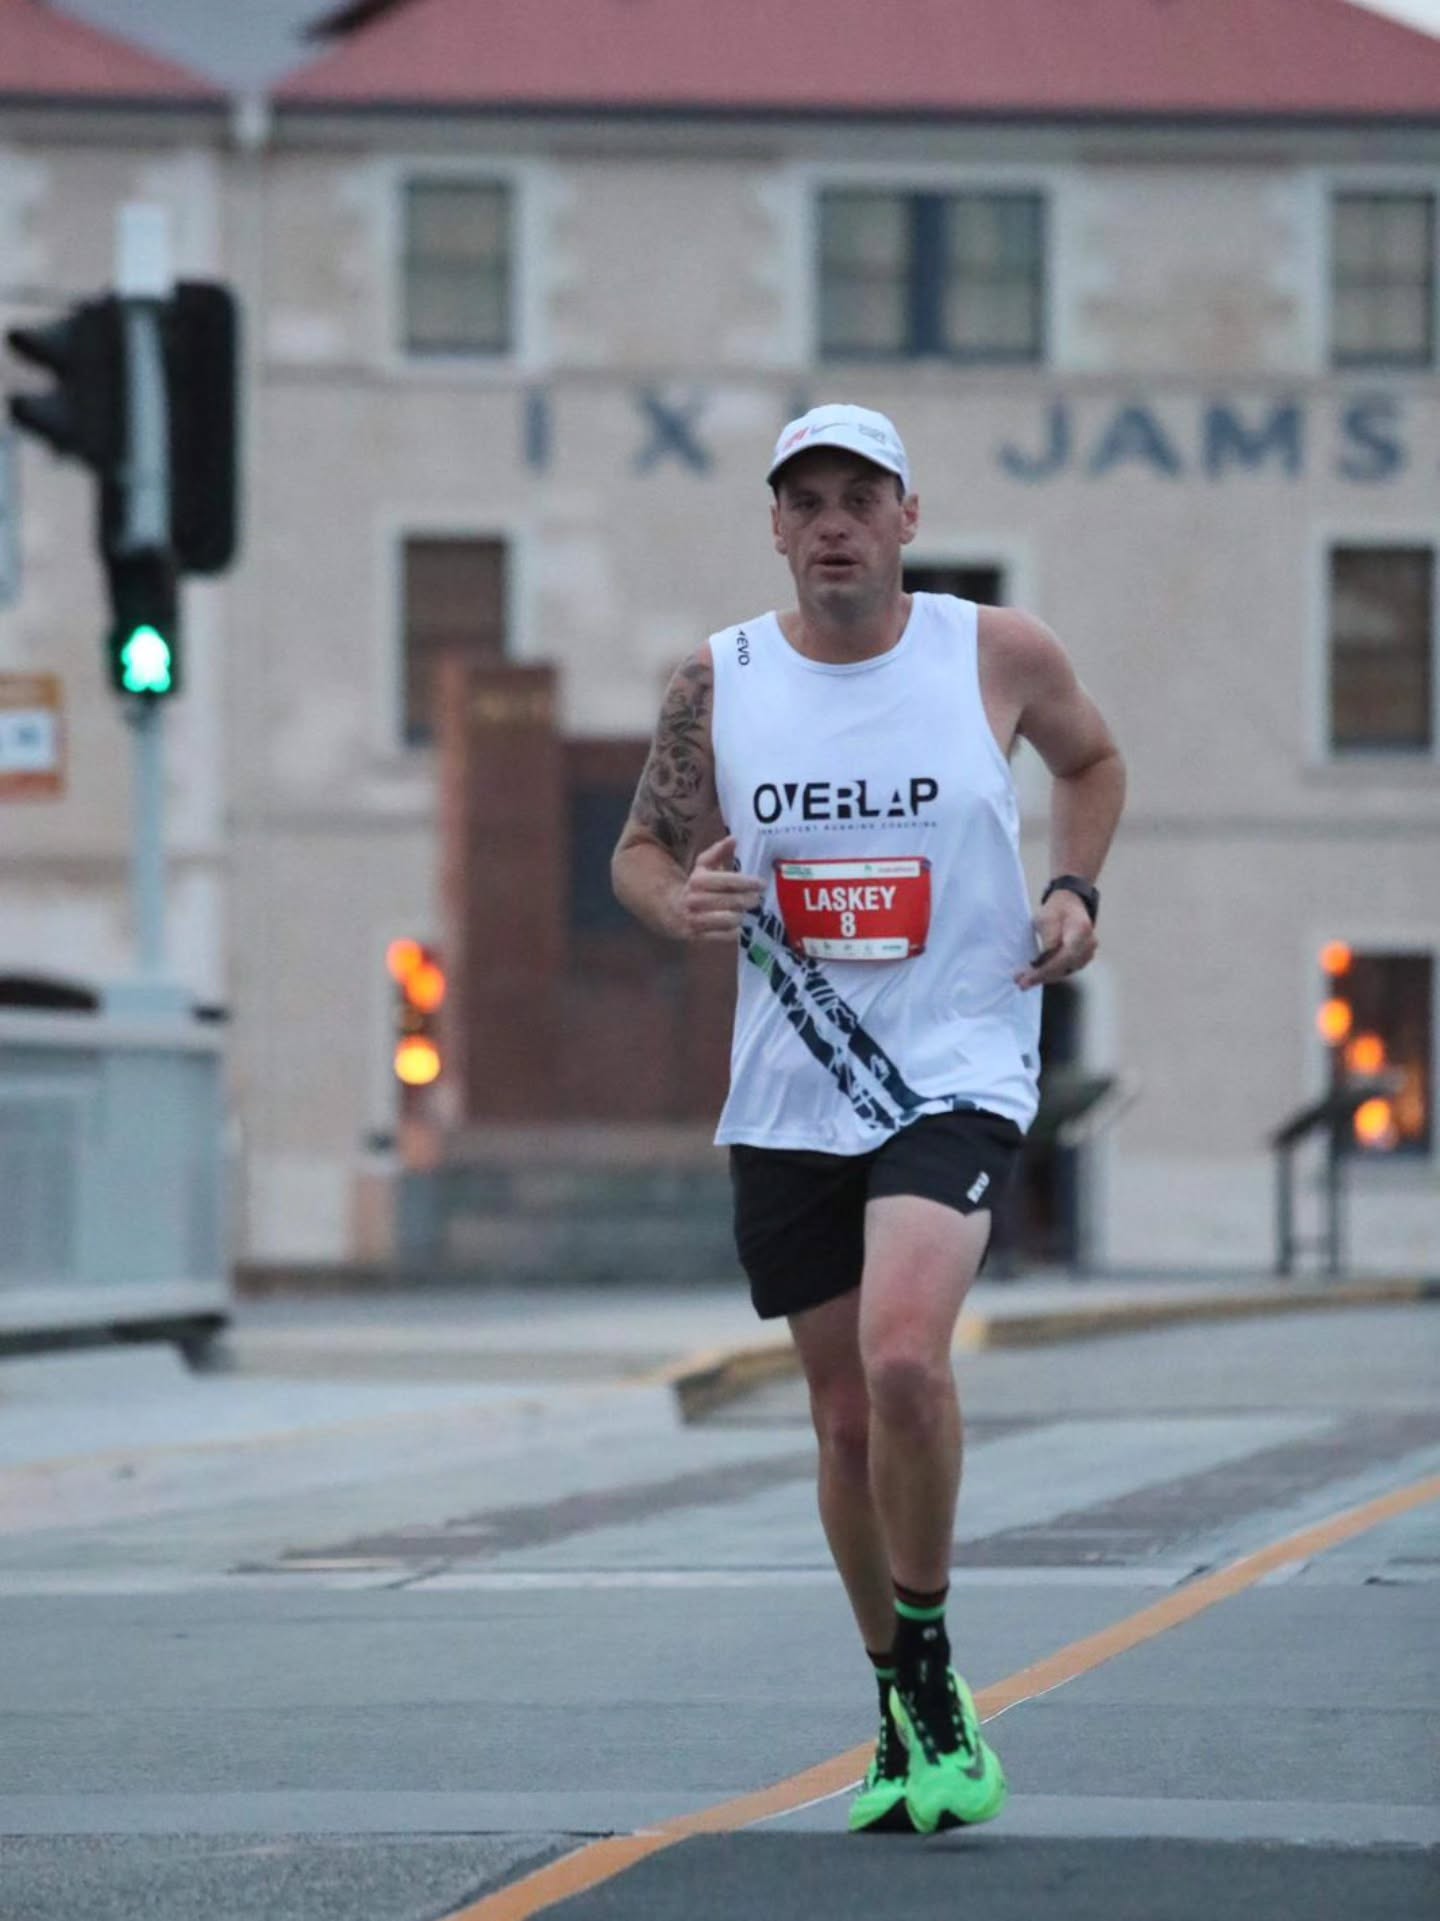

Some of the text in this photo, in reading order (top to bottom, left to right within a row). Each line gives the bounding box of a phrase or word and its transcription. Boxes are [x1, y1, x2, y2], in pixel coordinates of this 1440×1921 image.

[998, 396, 1407, 486] JAMS
[753, 777, 939, 824] OVERLAP
[803, 885, 896, 911] LASKEY
[840, 911, 857, 938] 8
